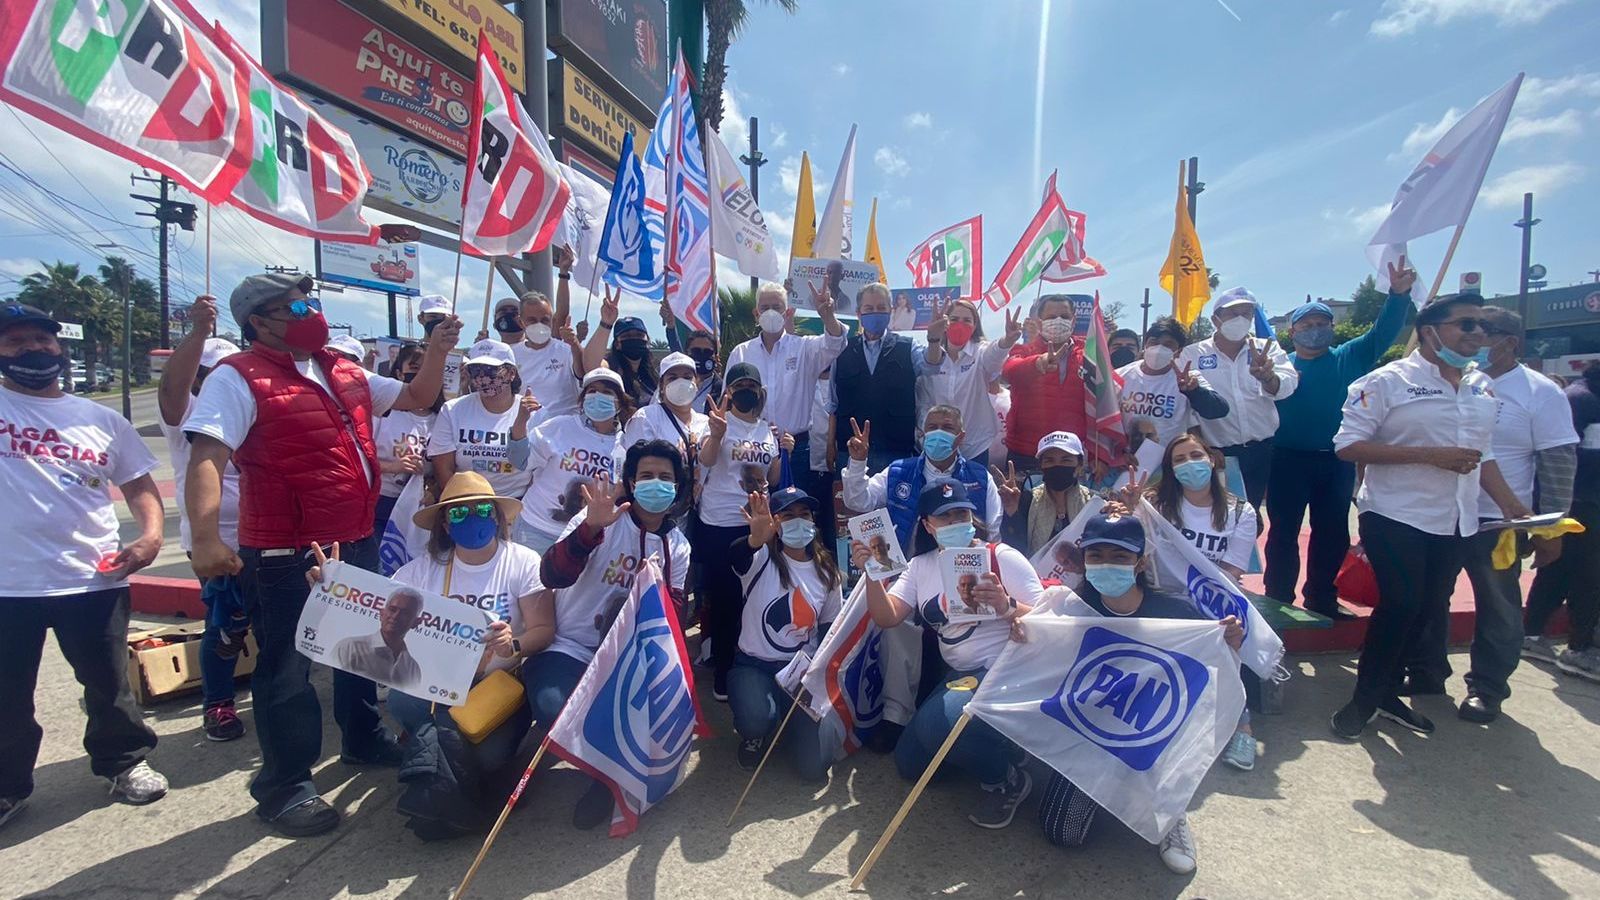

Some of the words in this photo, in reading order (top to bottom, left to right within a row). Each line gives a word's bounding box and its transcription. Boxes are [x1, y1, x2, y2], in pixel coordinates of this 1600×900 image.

[361, 28, 433, 77] Aquí
[440, 70, 465, 97] te
[380, 91, 395, 104] En
[405, 101, 450, 127] confiamos
[574, 76, 637, 138] SERVICIO
[606, 121, 612, 131] A
[383, 145, 460, 193] Romero's
[478, 117, 533, 221] RI
[794, 265, 826, 275] JORGE
[843, 269, 876, 281] RAMOS
[1120, 402, 1174, 419] RAMOS
[1122, 391, 1176, 408] JORGE
[11, 439, 109, 467] MACÍAS
[462, 449, 481, 457] BAJA
[315, 592, 381, 620] PRESIDENTE
[414, 627, 478, 652] MUNICIPAL
[321, 580, 386, 611] JORGE
[421, 611, 485, 645] RAMOS
[630, 639, 696, 754] PAN
[1077, 663, 1171, 732] PAN
